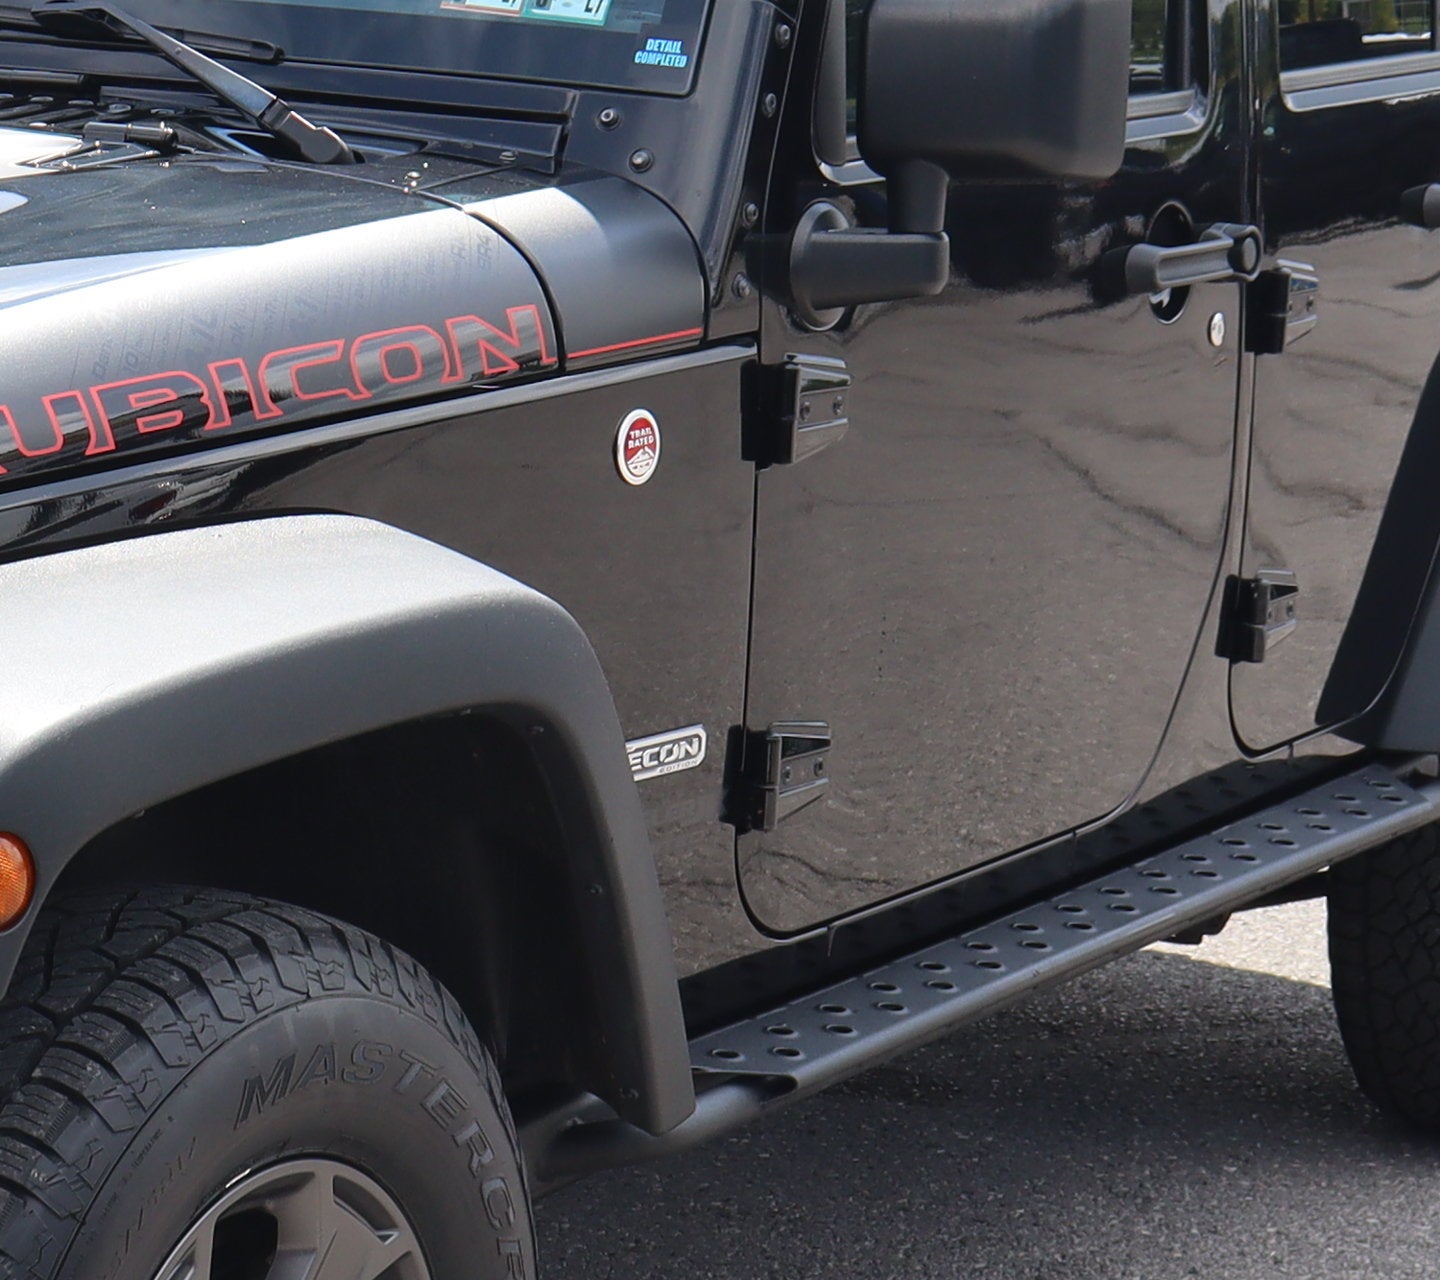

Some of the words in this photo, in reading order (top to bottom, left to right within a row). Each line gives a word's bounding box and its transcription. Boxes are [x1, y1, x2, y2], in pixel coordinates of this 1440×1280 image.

[646, 38, 682, 53] DETAIL
[634, 51, 688, 68] COMPLETED
[629, 427, 653, 439] TRAIL
[627, 435, 655, 449] RATED
[659, 760, 698, 773] EDITION
